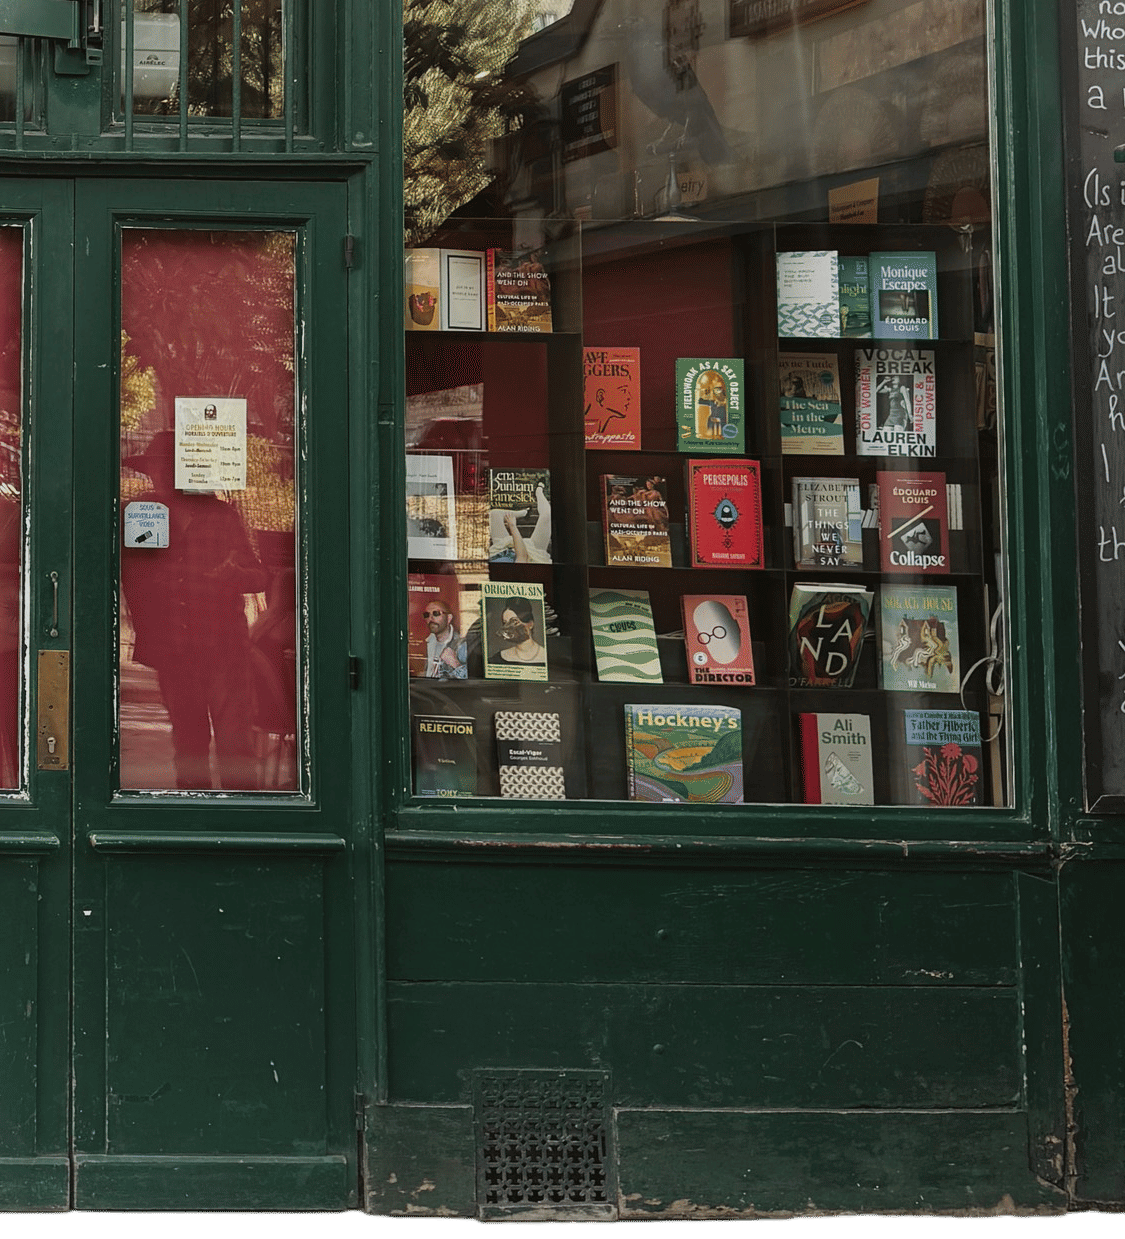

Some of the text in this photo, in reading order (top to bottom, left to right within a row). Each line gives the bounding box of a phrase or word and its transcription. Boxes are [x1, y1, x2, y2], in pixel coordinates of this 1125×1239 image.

[1087, 85, 1108, 110] a
[1085, 214, 1125, 247] Are
[880, 265, 928, 282] Monique
[882, 278, 926, 293] Escapes
[1094, 284, 1116, 319] It
[885, 316, 928, 325] ÉDOUARD
[893, 324, 920, 332] LOUIS
[584, 351, 609, 364] AVE
[863, 348, 927, 361] VOCAL
[584, 363, 629, 377] GGERS
[779, 360, 803, 370] ayne
[876, 361, 934, 374] BREAK
[683, 361, 739, 410] FIELDWORK AS A SEX OBJECT
[925, 375, 935, 420] POWER
[785, 400, 829, 411] The Sea
[913, 381, 925, 433] MUSIC &
[792, 411, 825, 422] in the
[861, 412, 872, 430] ON
[790, 423, 826, 435] Metro
[585, 431, 636, 444] ntrapposto
[862, 431, 927, 445] LAUREN
[888, 444, 935, 457] ELKIN
[703, 473, 748, 486] PERSEPOLIS
[798, 483, 856, 493] ELIZABETH
[892, 487, 937, 497] ÉDOUARD
[805, 494, 848, 503] STROUT
[902, 496, 929, 504] LOUIS
[817, 509, 838, 517] THE
[808, 520, 849, 530] THINGS
[821, 532, 837, 542] WE
[811, 544, 848, 555] NEVER
[820, 556, 840, 566] SAY
[890, 550, 946, 569] Collapse
[484, 584, 544, 596] ORIGINAL SIN
[695, 673, 753, 683] DIRECTOR
[637, 711, 738, 732] Hockney's
[833, 718, 853, 732] Ali
[419, 723, 474, 735] REJECTION
[821, 731, 867, 745] Smith
